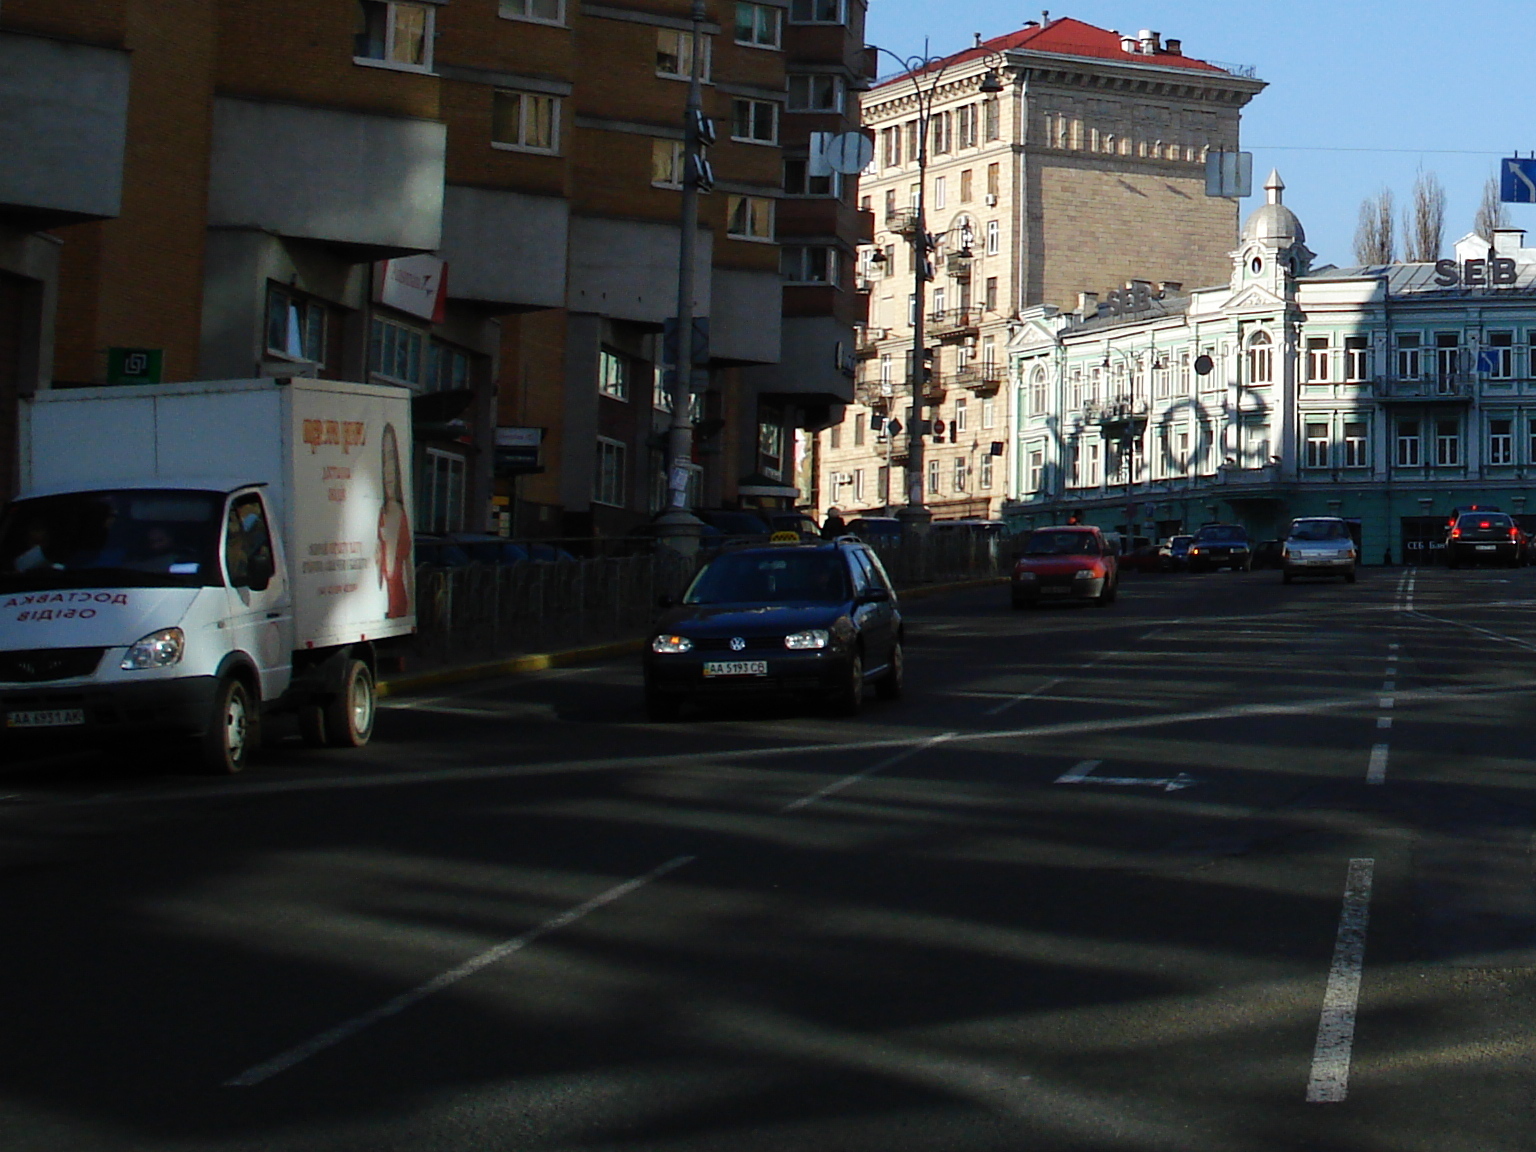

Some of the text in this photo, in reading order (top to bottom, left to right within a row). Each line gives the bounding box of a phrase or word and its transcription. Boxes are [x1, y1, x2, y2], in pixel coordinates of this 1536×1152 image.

[1433, 257, 1518, 287] SEB
[1106, 283, 1152, 317] SEB
[1407, 541, 1425, 550] СЕБ
[710, 663, 724, 673] AA
[726, 662, 749, 673] 5193
[15, 713, 31, 724] AA
